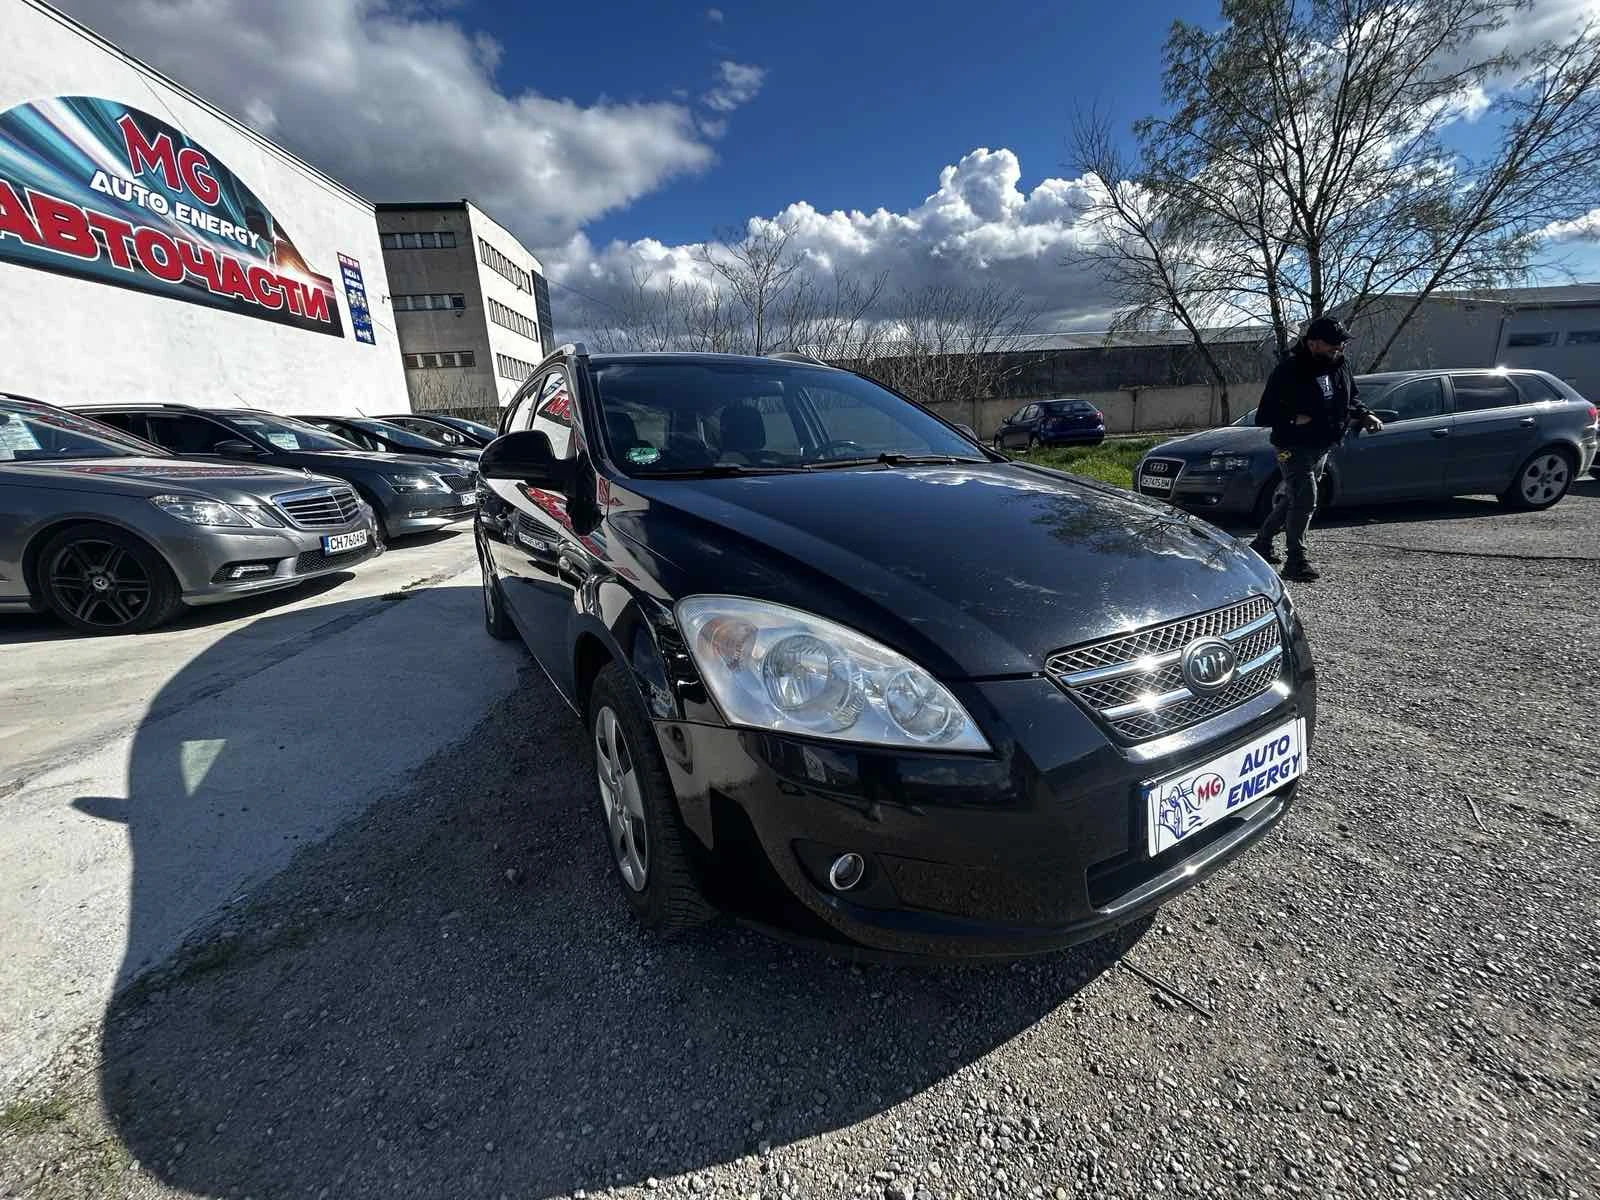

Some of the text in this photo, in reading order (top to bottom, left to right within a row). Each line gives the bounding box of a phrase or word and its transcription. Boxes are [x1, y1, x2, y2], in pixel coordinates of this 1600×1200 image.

[117, 113, 220, 206] MG
[89, 169, 260, 249] AUTO ENERGY
[0, 180, 331, 323] АВТОЧАСТИ
[1226, 752, 1301, 809] ENERGY
[1239, 734, 1290, 777] AUTO
[1196, 781, 1222, 801] MG
